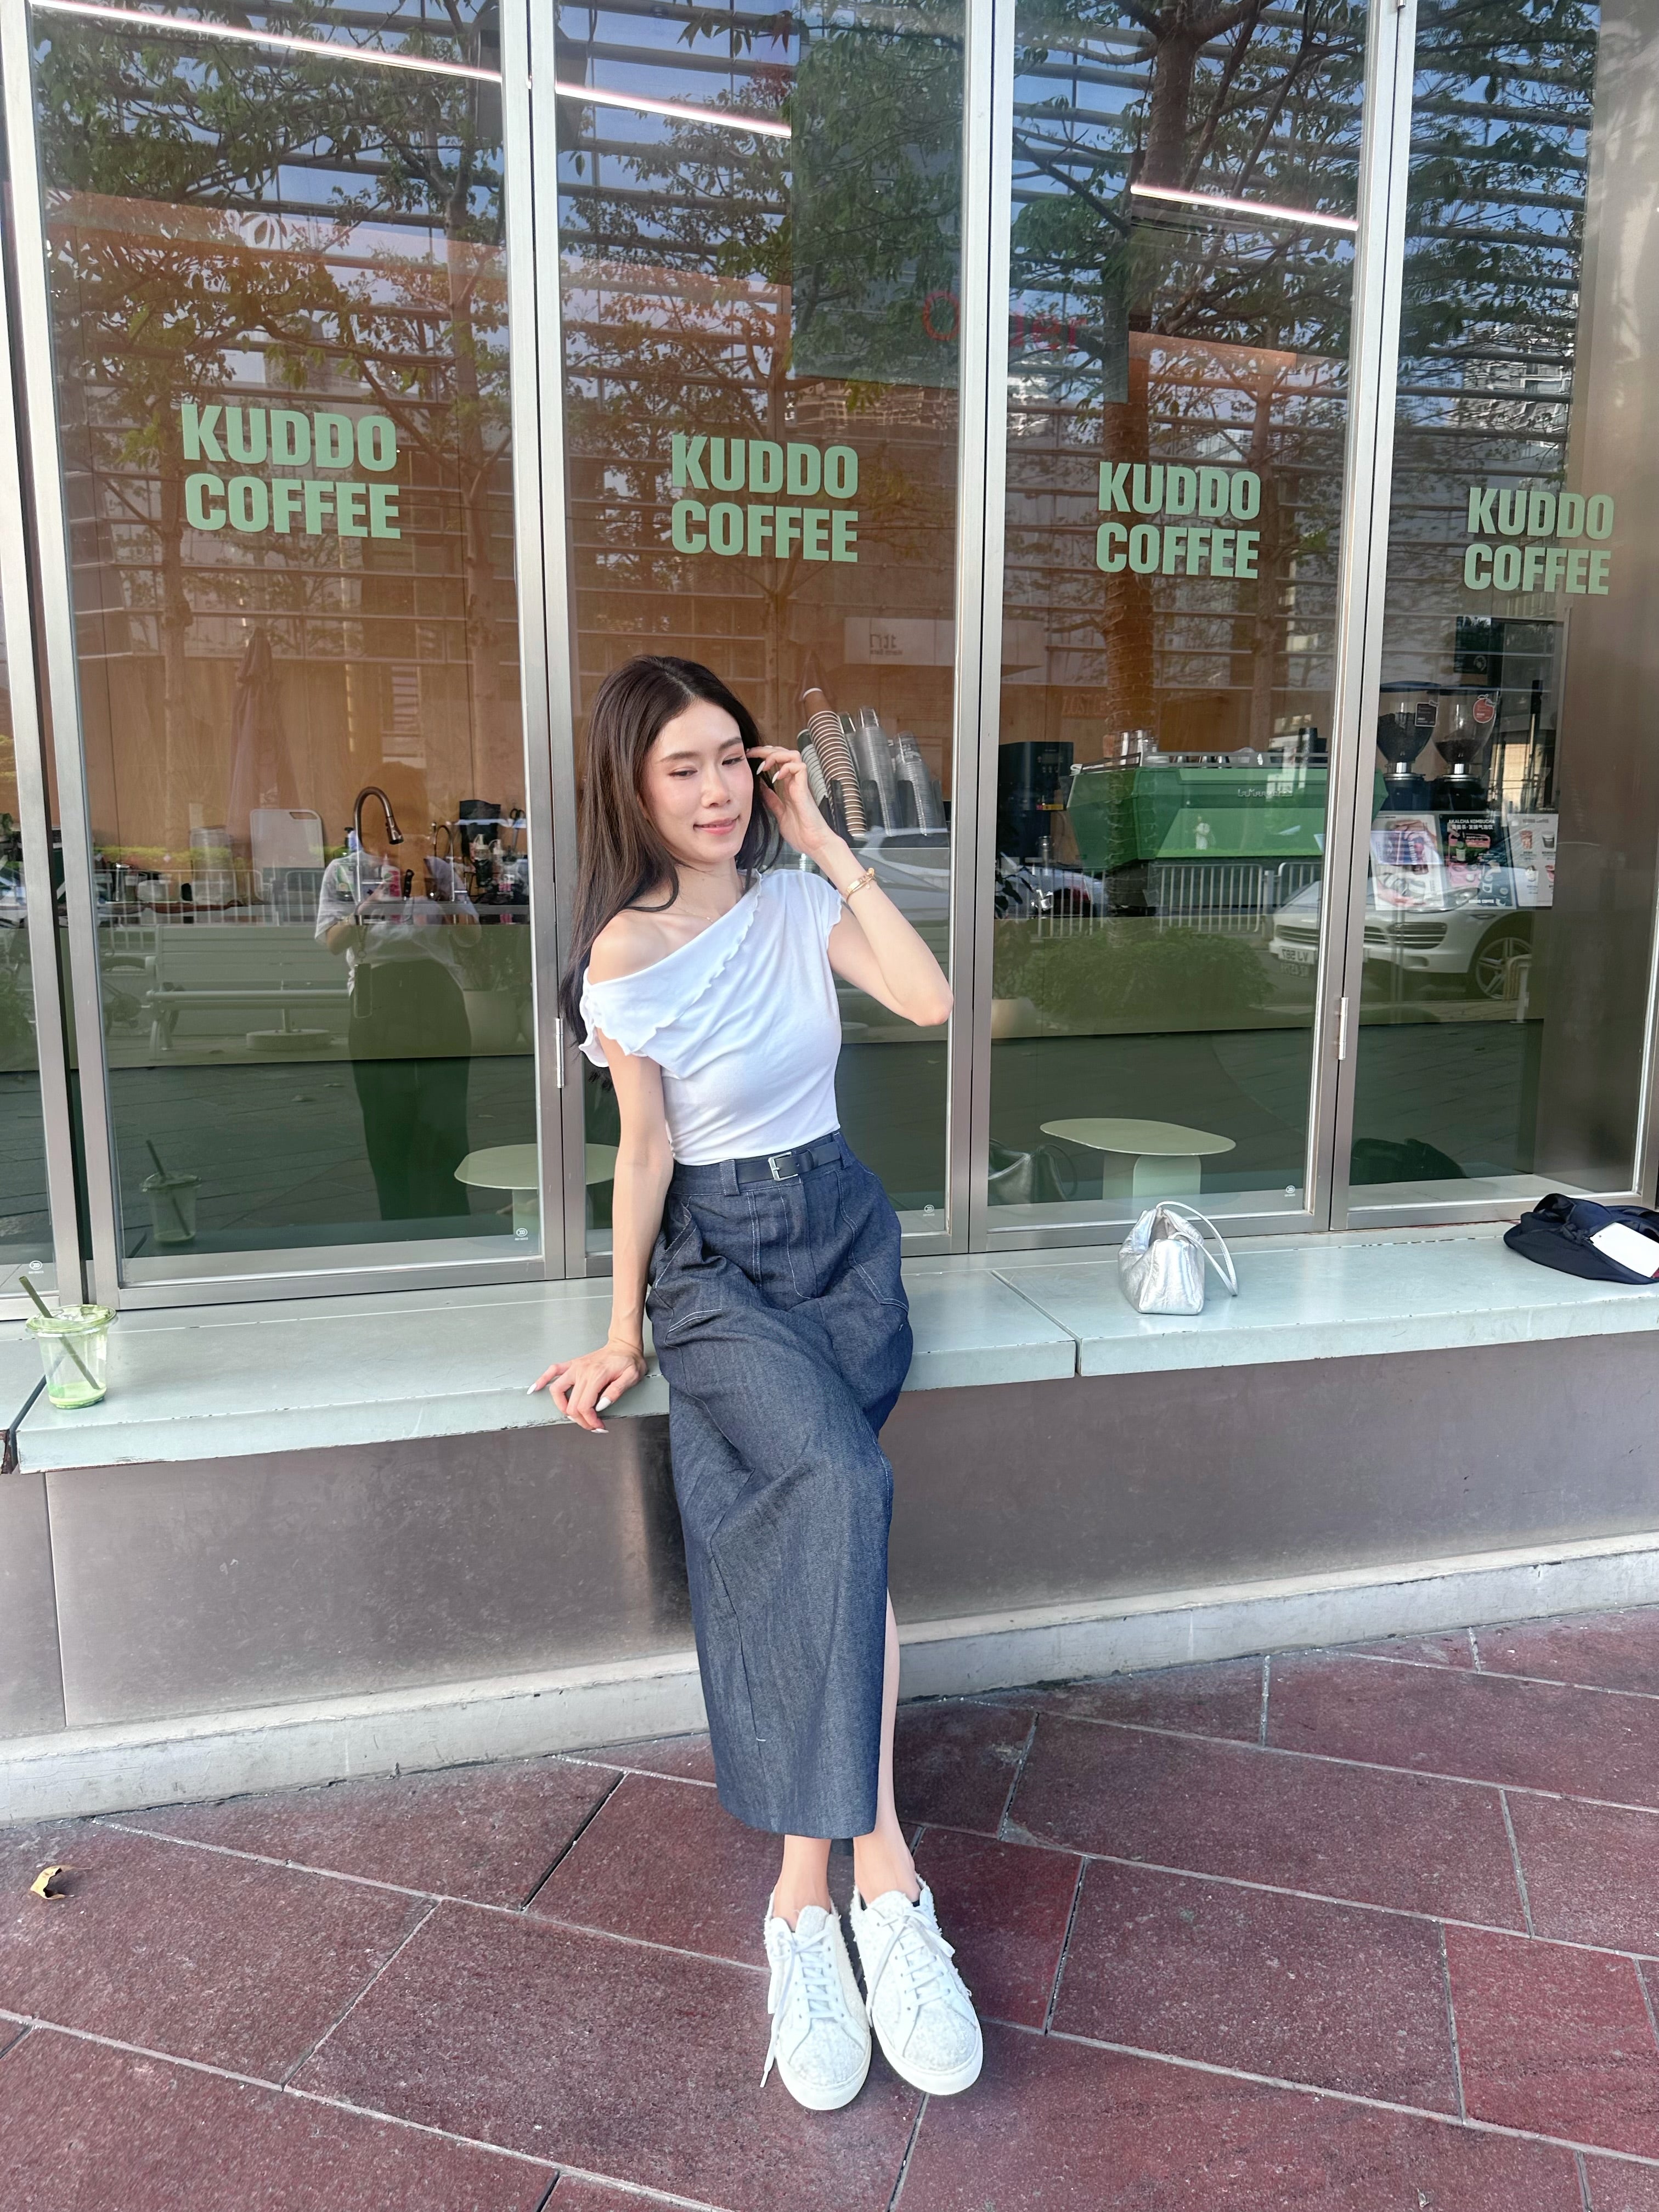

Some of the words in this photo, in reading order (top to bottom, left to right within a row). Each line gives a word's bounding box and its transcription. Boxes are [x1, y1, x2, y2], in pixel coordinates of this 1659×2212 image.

[182, 404, 397, 472] KUDDO
[670, 433, 859, 498] KUDDO
[185, 473, 401, 539] COFFEE
[1098, 462, 1261, 520] KUDDO
[1468, 487, 1614, 540] KUDDO
[670, 499, 860, 563] COFFEE
[1096, 522, 1260, 579] COFFEE
[1464, 544, 1611, 595] COFFEE
